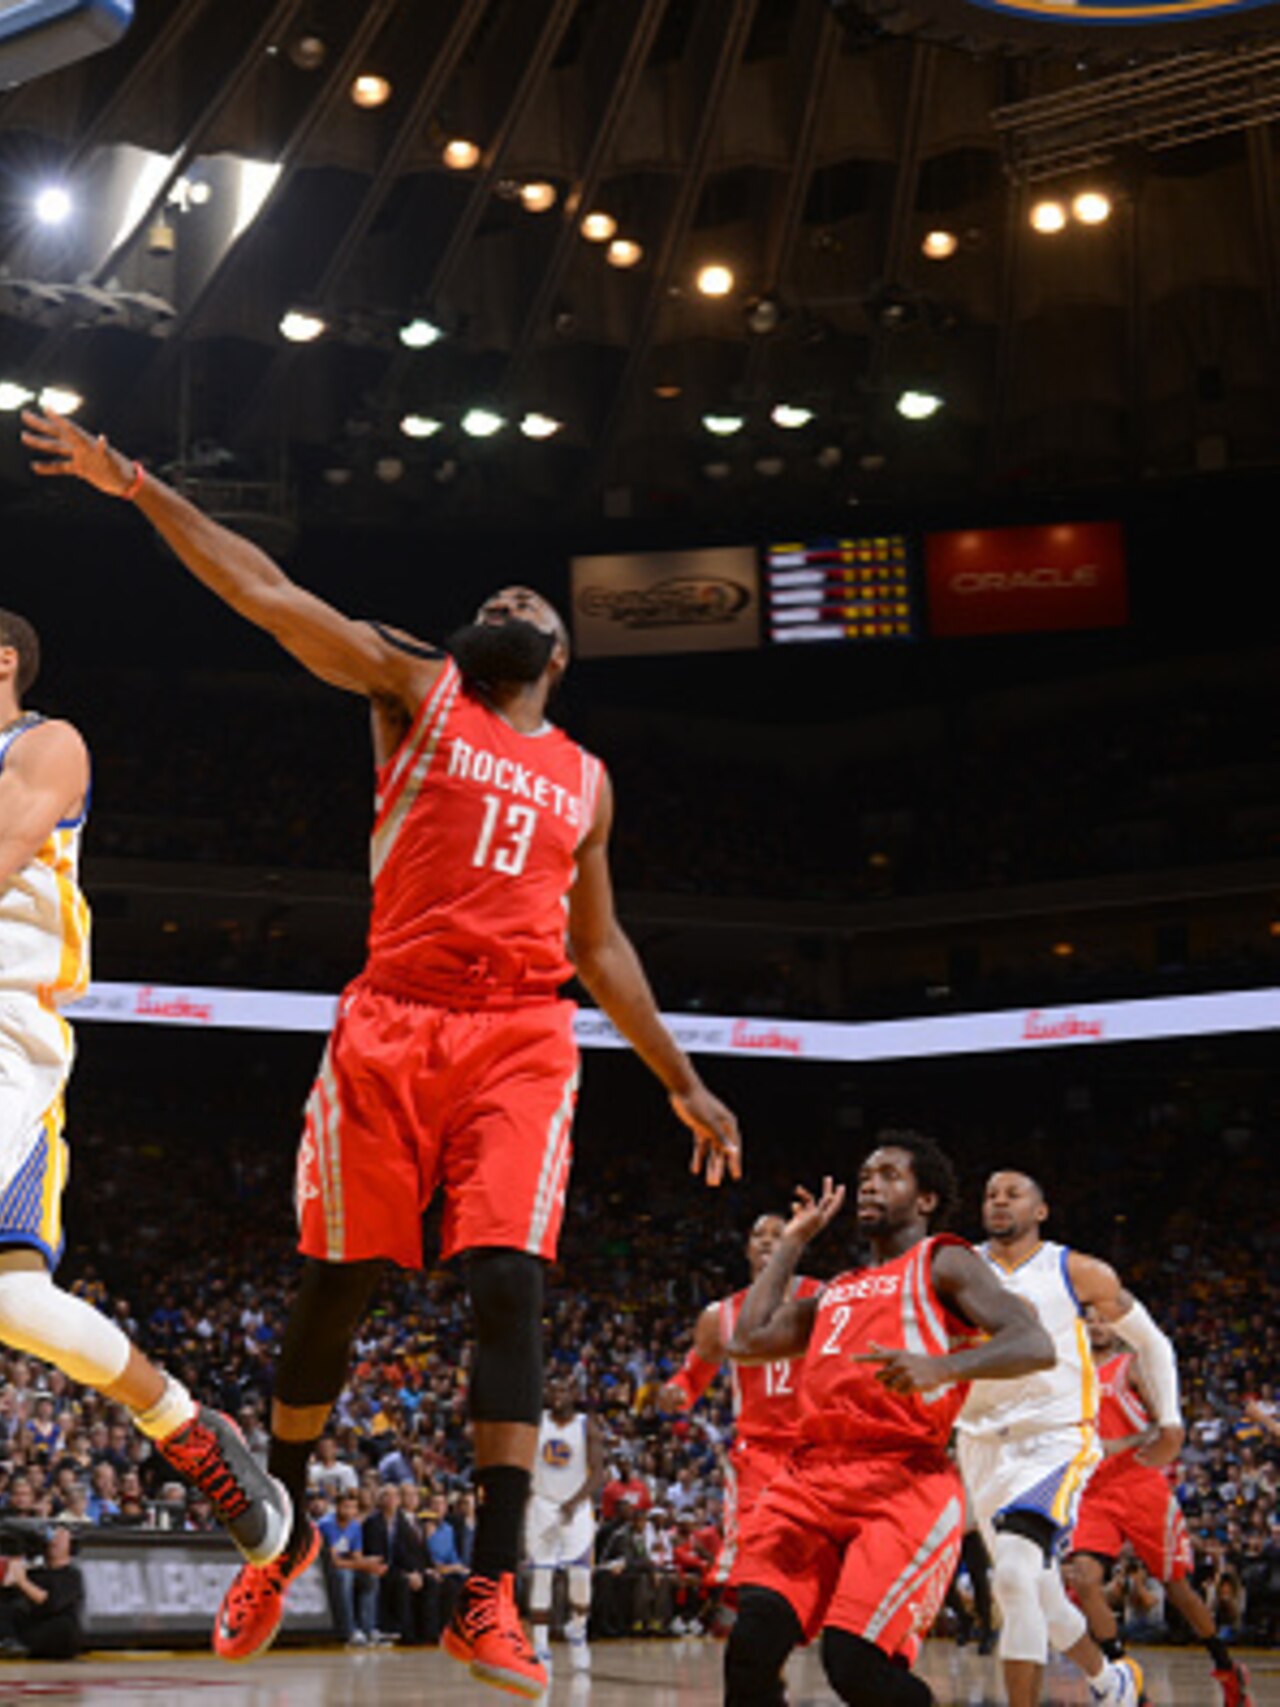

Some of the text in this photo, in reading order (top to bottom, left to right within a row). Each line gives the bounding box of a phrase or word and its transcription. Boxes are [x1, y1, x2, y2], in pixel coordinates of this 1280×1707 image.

[948, 563, 1099, 595] ORACLE
[447, 736, 581, 828] ROCKETS
[471, 794, 538, 877] 13
[821, 1305, 852, 1355] 2
[764, 1360, 793, 1398] 12
